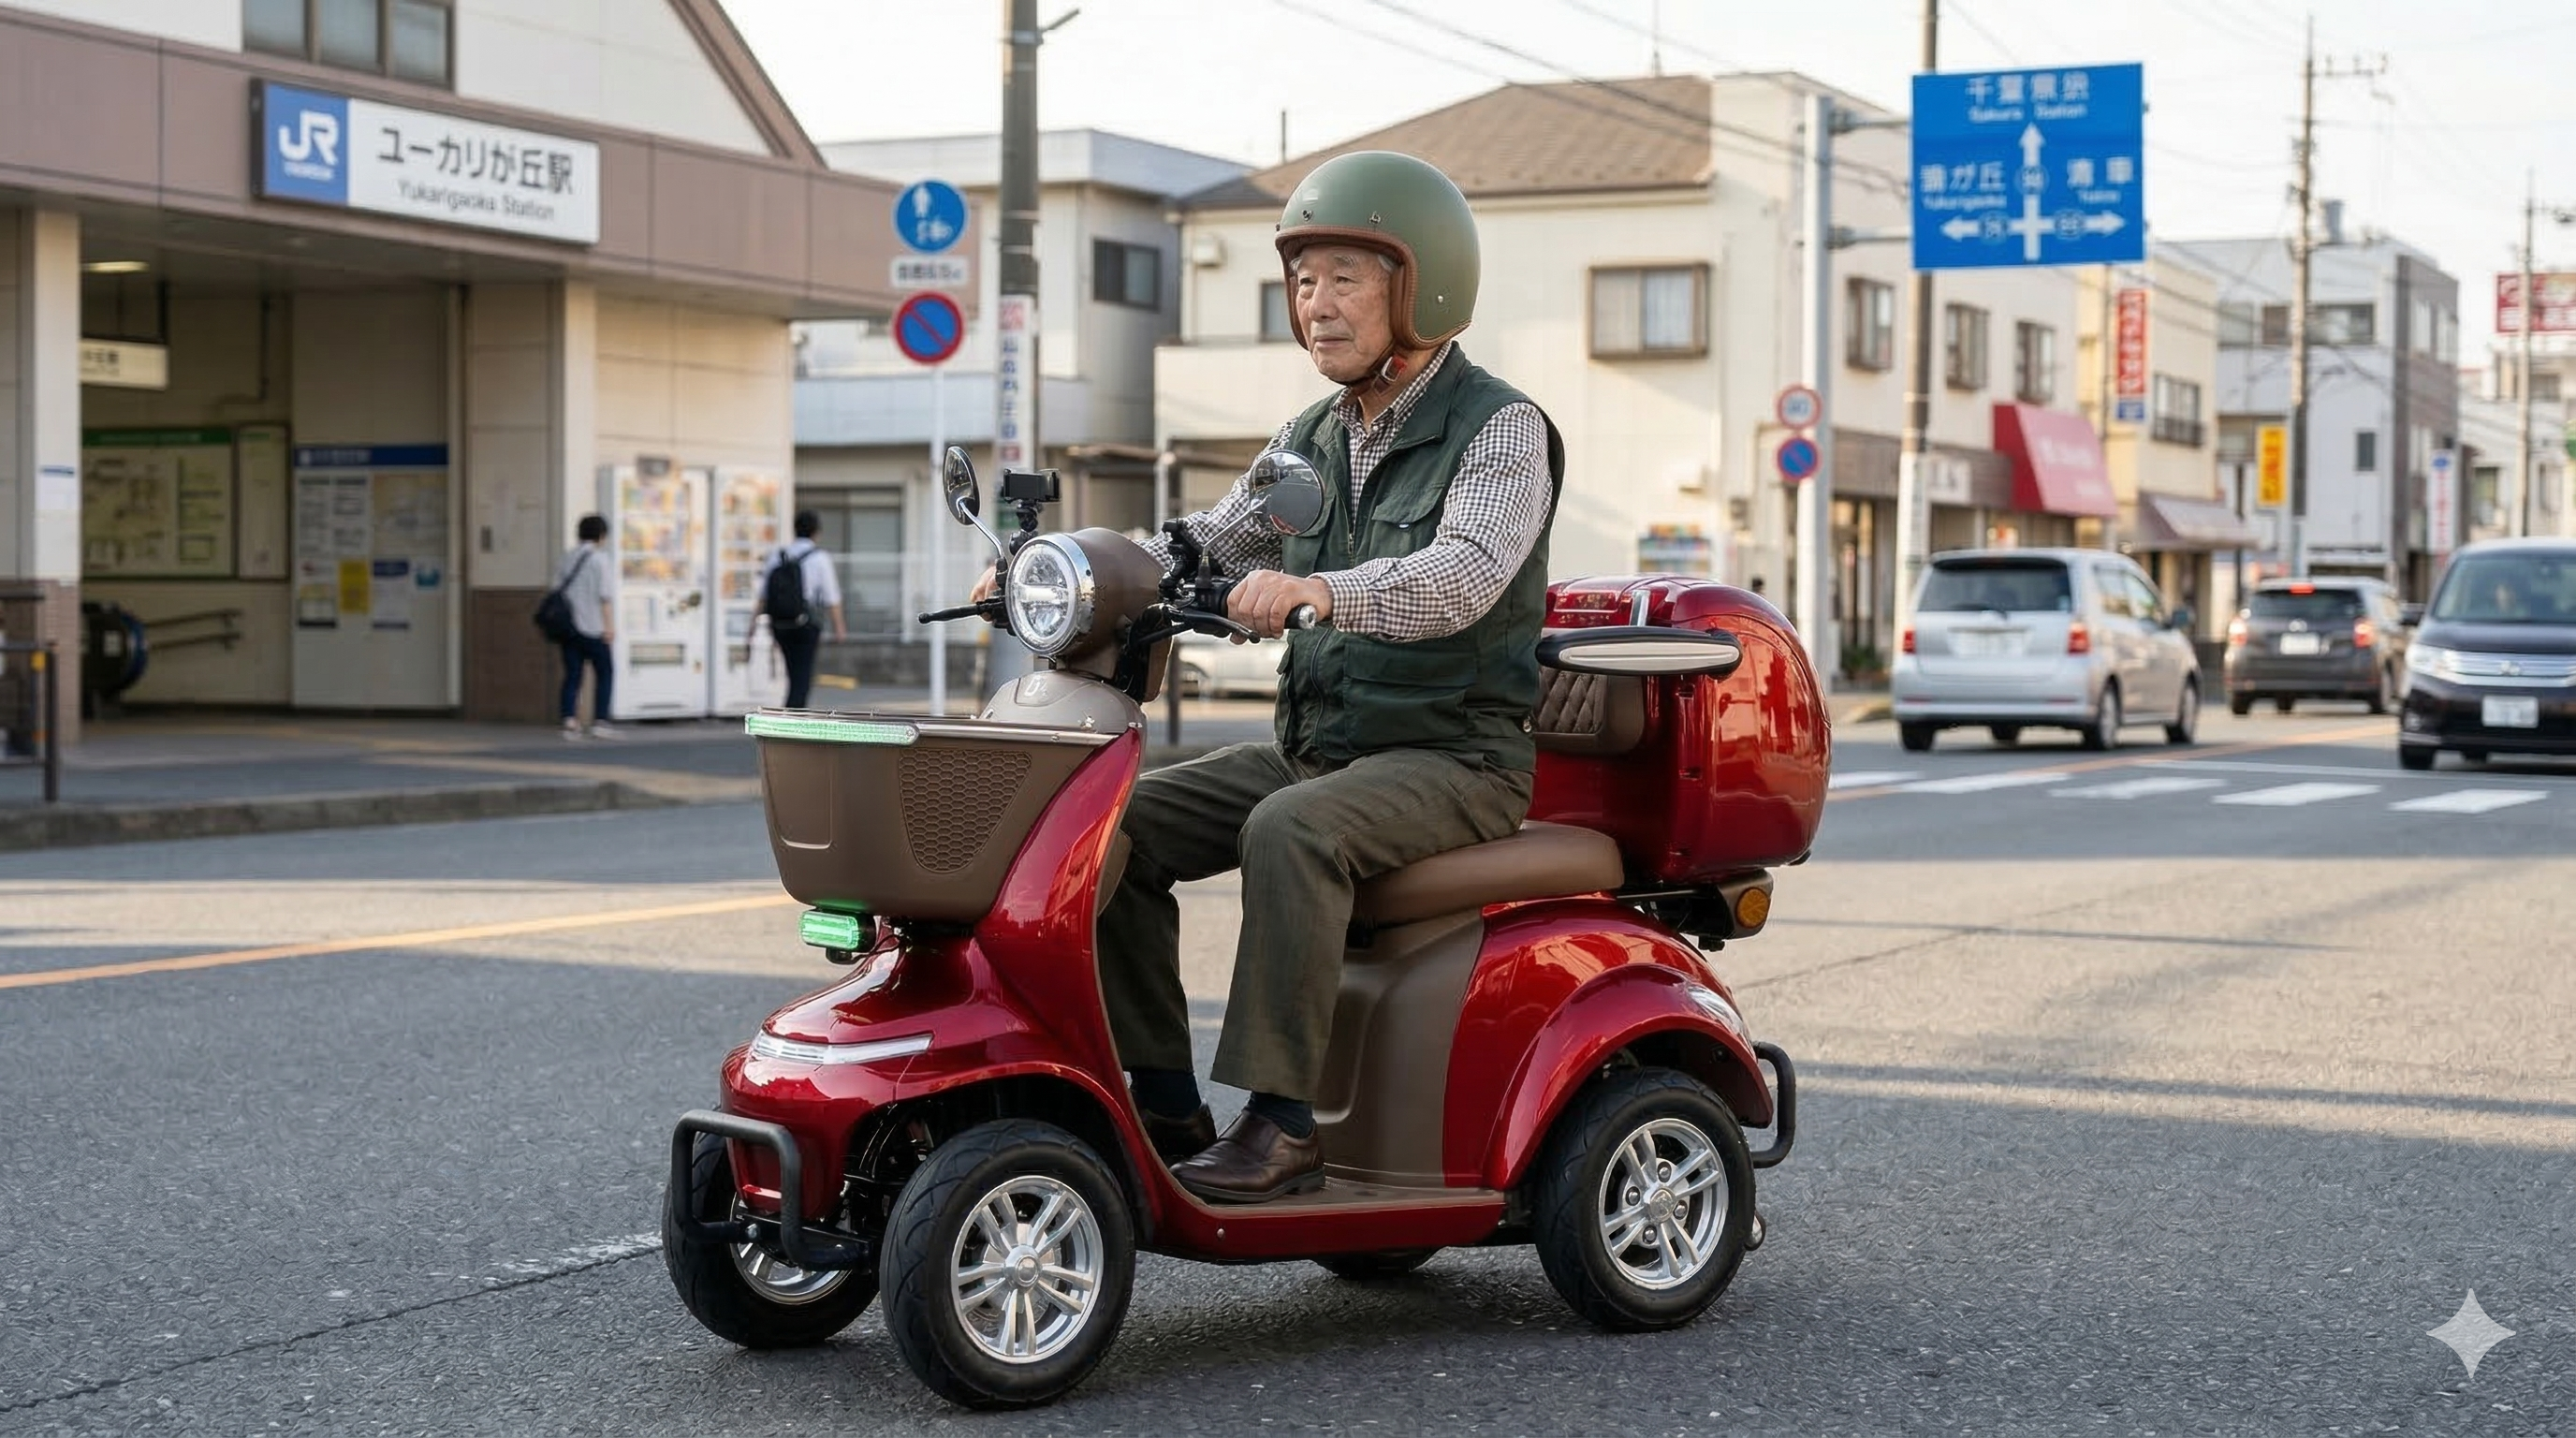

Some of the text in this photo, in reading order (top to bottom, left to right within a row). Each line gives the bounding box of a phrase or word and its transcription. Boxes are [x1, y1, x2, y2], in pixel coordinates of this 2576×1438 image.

[279, 110, 339, 166] JR
[379, 127, 573, 194] ユーカリが丘駅
[399, 180, 555, 220] Yukarigaoka Station
